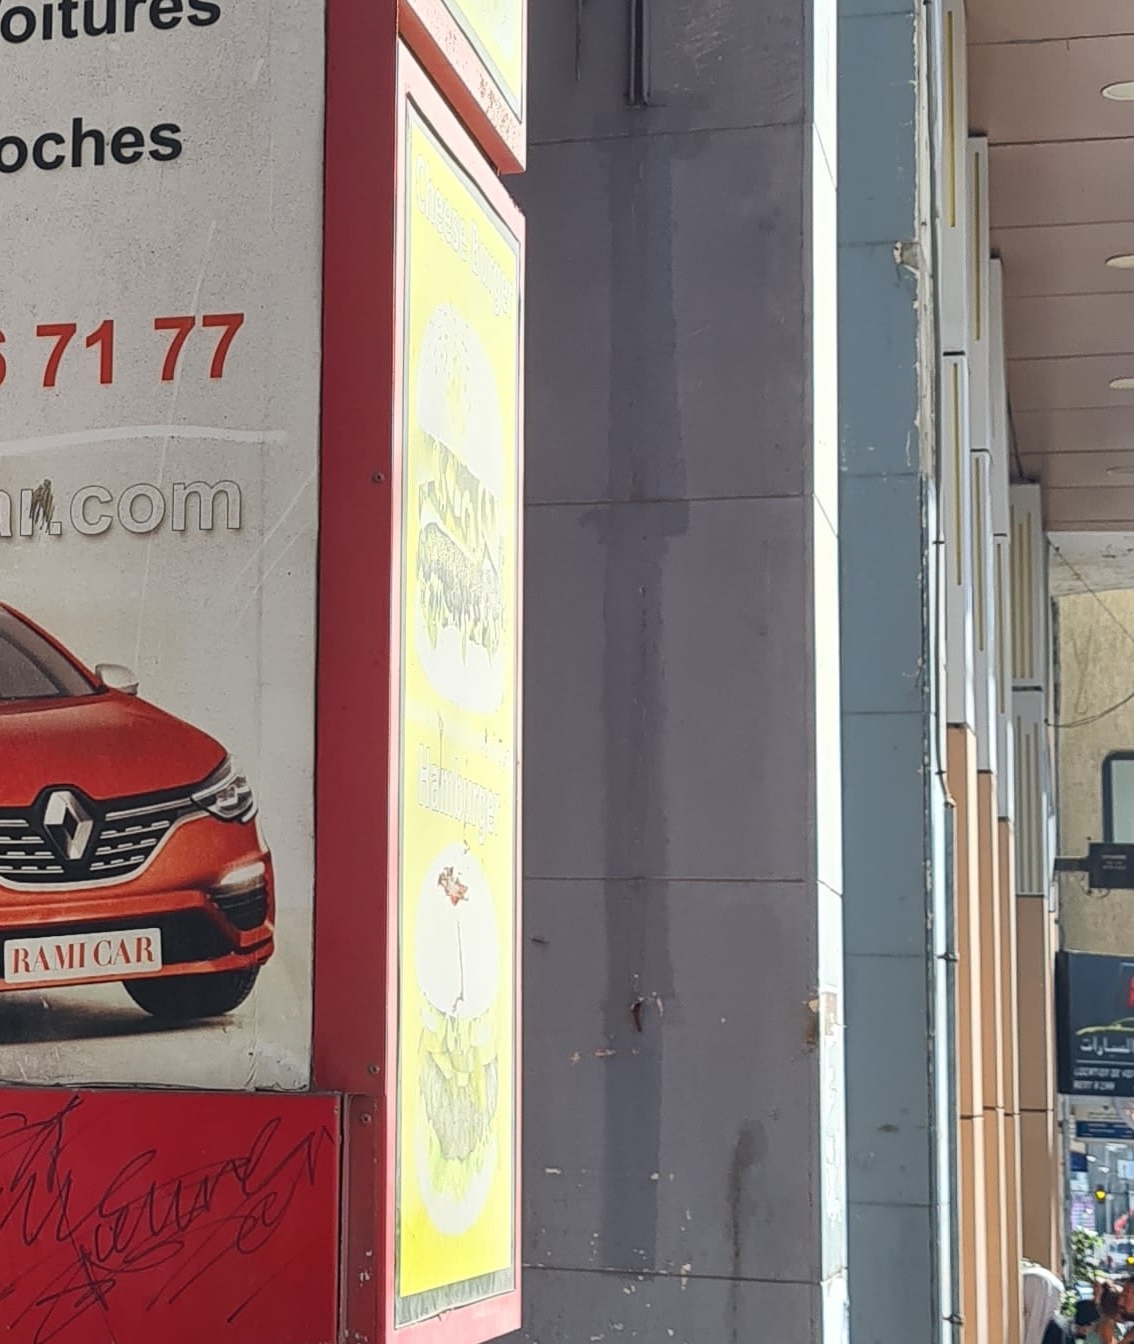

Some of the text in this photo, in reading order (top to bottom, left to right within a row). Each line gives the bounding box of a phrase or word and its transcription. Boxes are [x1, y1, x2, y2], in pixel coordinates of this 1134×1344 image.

[35, 319, 114, 387] 71
[152, 312, 245, 382] 77
[12, 935, 155, 975] RAMI CAR
